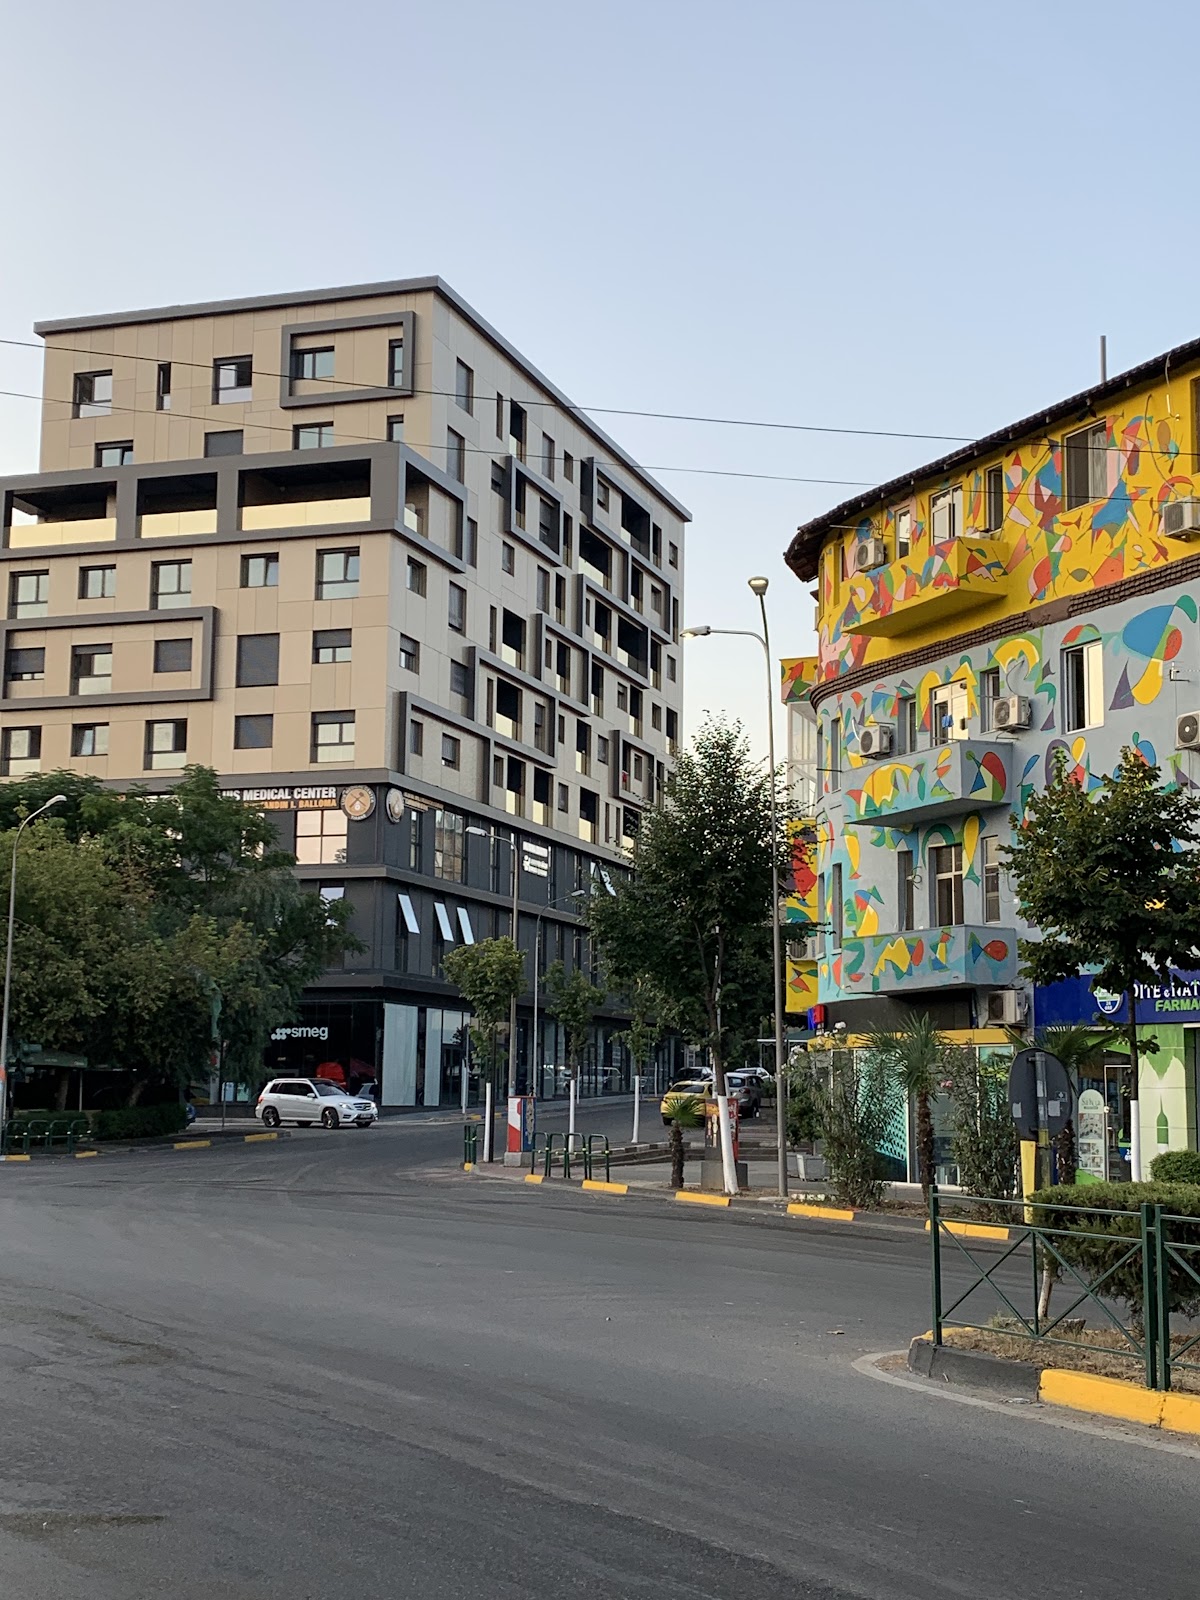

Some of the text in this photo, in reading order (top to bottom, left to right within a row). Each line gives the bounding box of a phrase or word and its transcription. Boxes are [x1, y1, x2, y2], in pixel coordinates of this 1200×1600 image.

[243, 788, 291, 801] MEDICAL
[293, 787, 336, 799] CENTER
[1155, 999, 1200, 1012] FARMA
[291, 1027, 328, 1040] smeg
